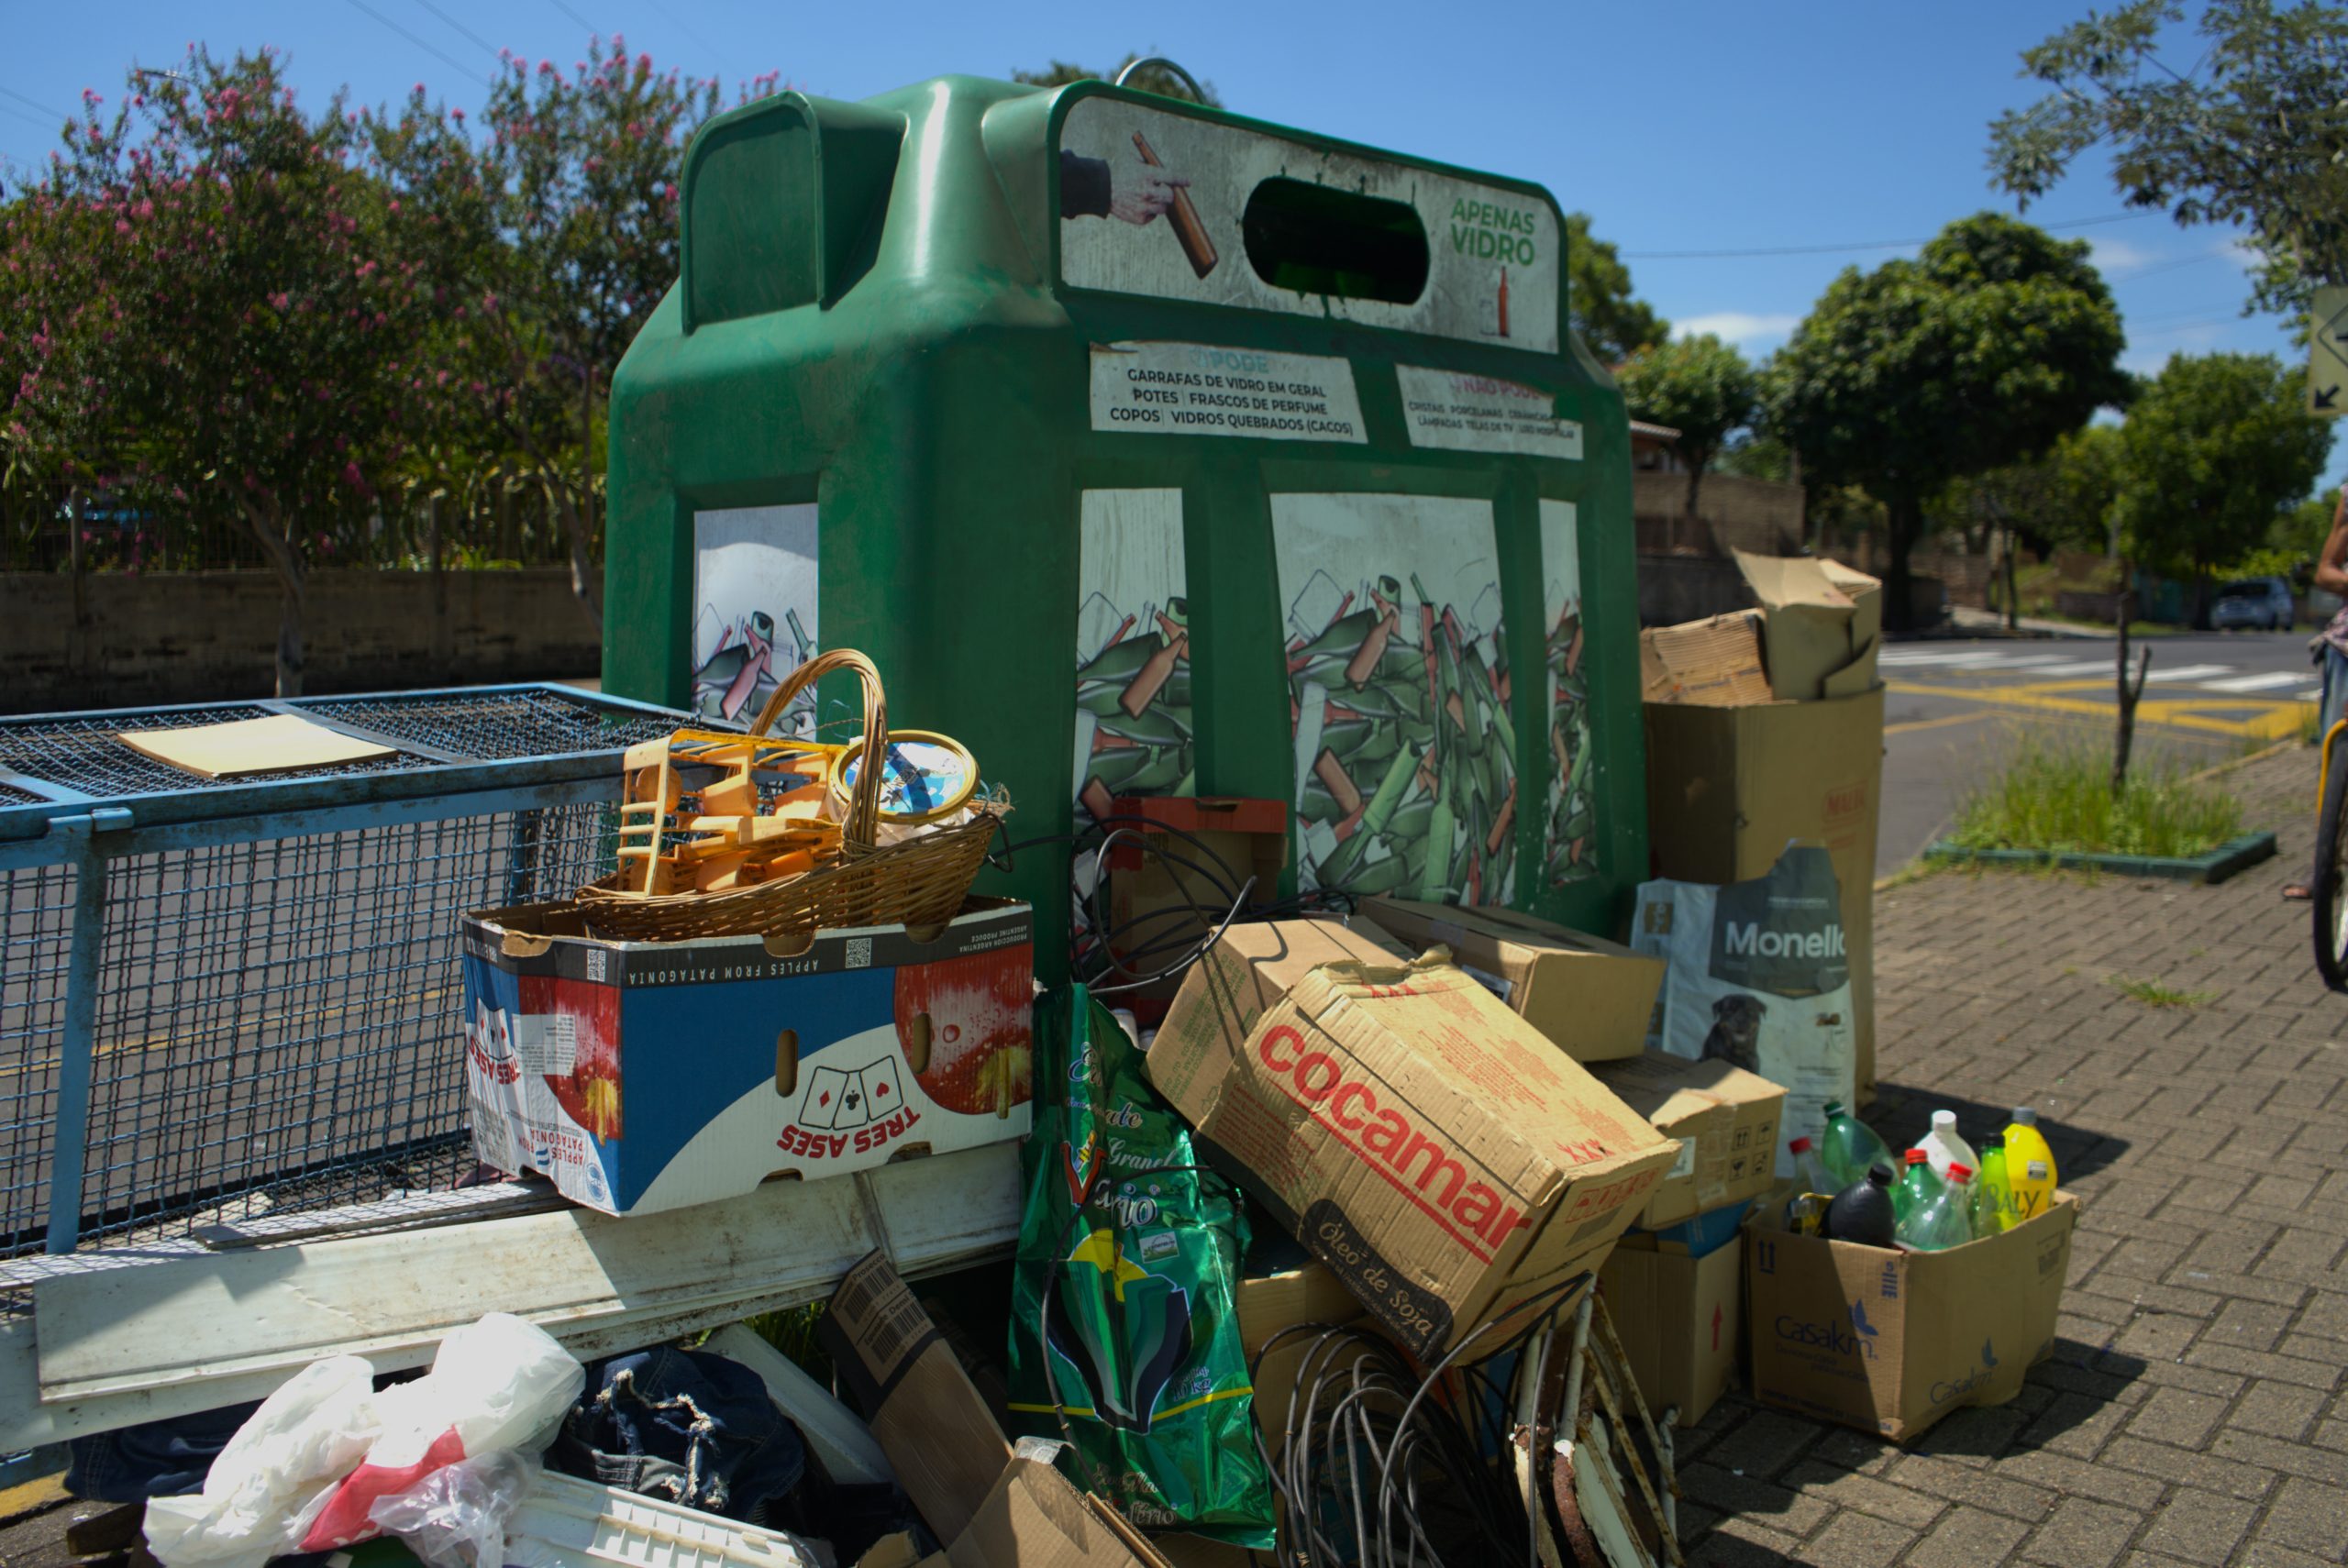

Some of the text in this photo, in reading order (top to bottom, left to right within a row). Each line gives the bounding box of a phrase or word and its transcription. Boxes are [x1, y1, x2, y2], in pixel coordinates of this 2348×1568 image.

[1451, 198, 1534, 235] APENAS
[1451, 224, 1535, 266] VIDRO
[1212, 351, 1269, 374] PODE
[1127, 369, 1326, 397] GARRAFAS DE VIDRO EM GERAL
[1133, 389, 1327, 414] POTES FRASCOS DE PERFUME
[1110, 407, 1354, 436] COPOS VIDROS QUEBRADOS (CACOS)
[959, 941, 992, 953] ARGENTINA
[971, 925, 1027, 943] ARGENTINE PRODUCE
[628, 958, 819, 986] APPLES FROM PATAGONIA
[469, 1035, 495, 1080] ASES
[530, 1128, 583, 1152] PATAGONIA
[776, 1105, 921, 1158] TRES ASES
[1260, 1023, 1534, 1251] cocamar
[551, 1146, 583, 1165] APPLES
[852, 1253, 886, 1281] Prosecco
[1319, 1220, 1361, 1268] Óleo
[1363, 1262, 1389, 1297] de
[1390, 1287, 1435, 1340] Soja
[888, 1290, 910, 1317] Demi
[1192, 1378, 1212, 1394] kg
